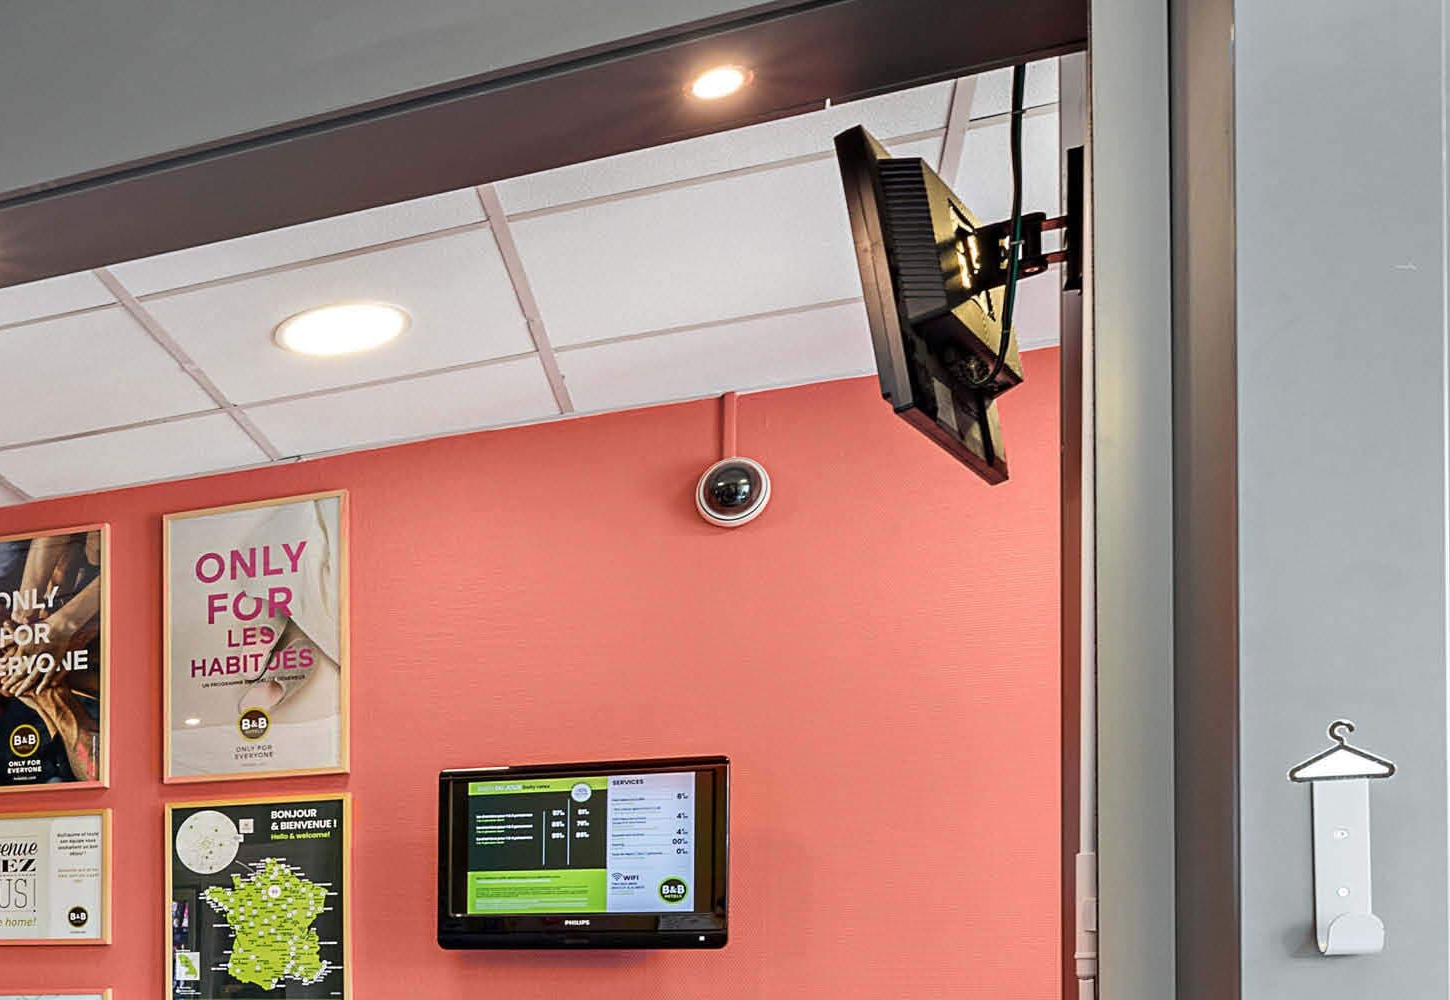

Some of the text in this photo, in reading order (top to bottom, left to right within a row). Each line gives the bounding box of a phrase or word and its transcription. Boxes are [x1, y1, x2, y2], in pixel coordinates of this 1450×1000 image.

[195, 541, 307, 583] ONLY
[208, 587, 293, 625] FOR
[0, 623, 51, 648] FOR
[228, 626, 275, 648] LES
[191, 646, 314, 678] HABITUÉS
[242, 717, 268, 730] B&B
[13, 734, 37, 746] B&B
[236, 745, 255, 753] ONLY
[235, 751, 274, 760] EVERYONE
[7, 766, 42, 774] EVERYONE
[271, 809, 317, 819] BONJOUR
[271, 822, 279, 830] &
[280, 820, 332, 830] BIENVENUE
[662, 884, 685, 895] B&B
[5, 916, 36, 927] home!
[70, 912, 86, 921] B&B
